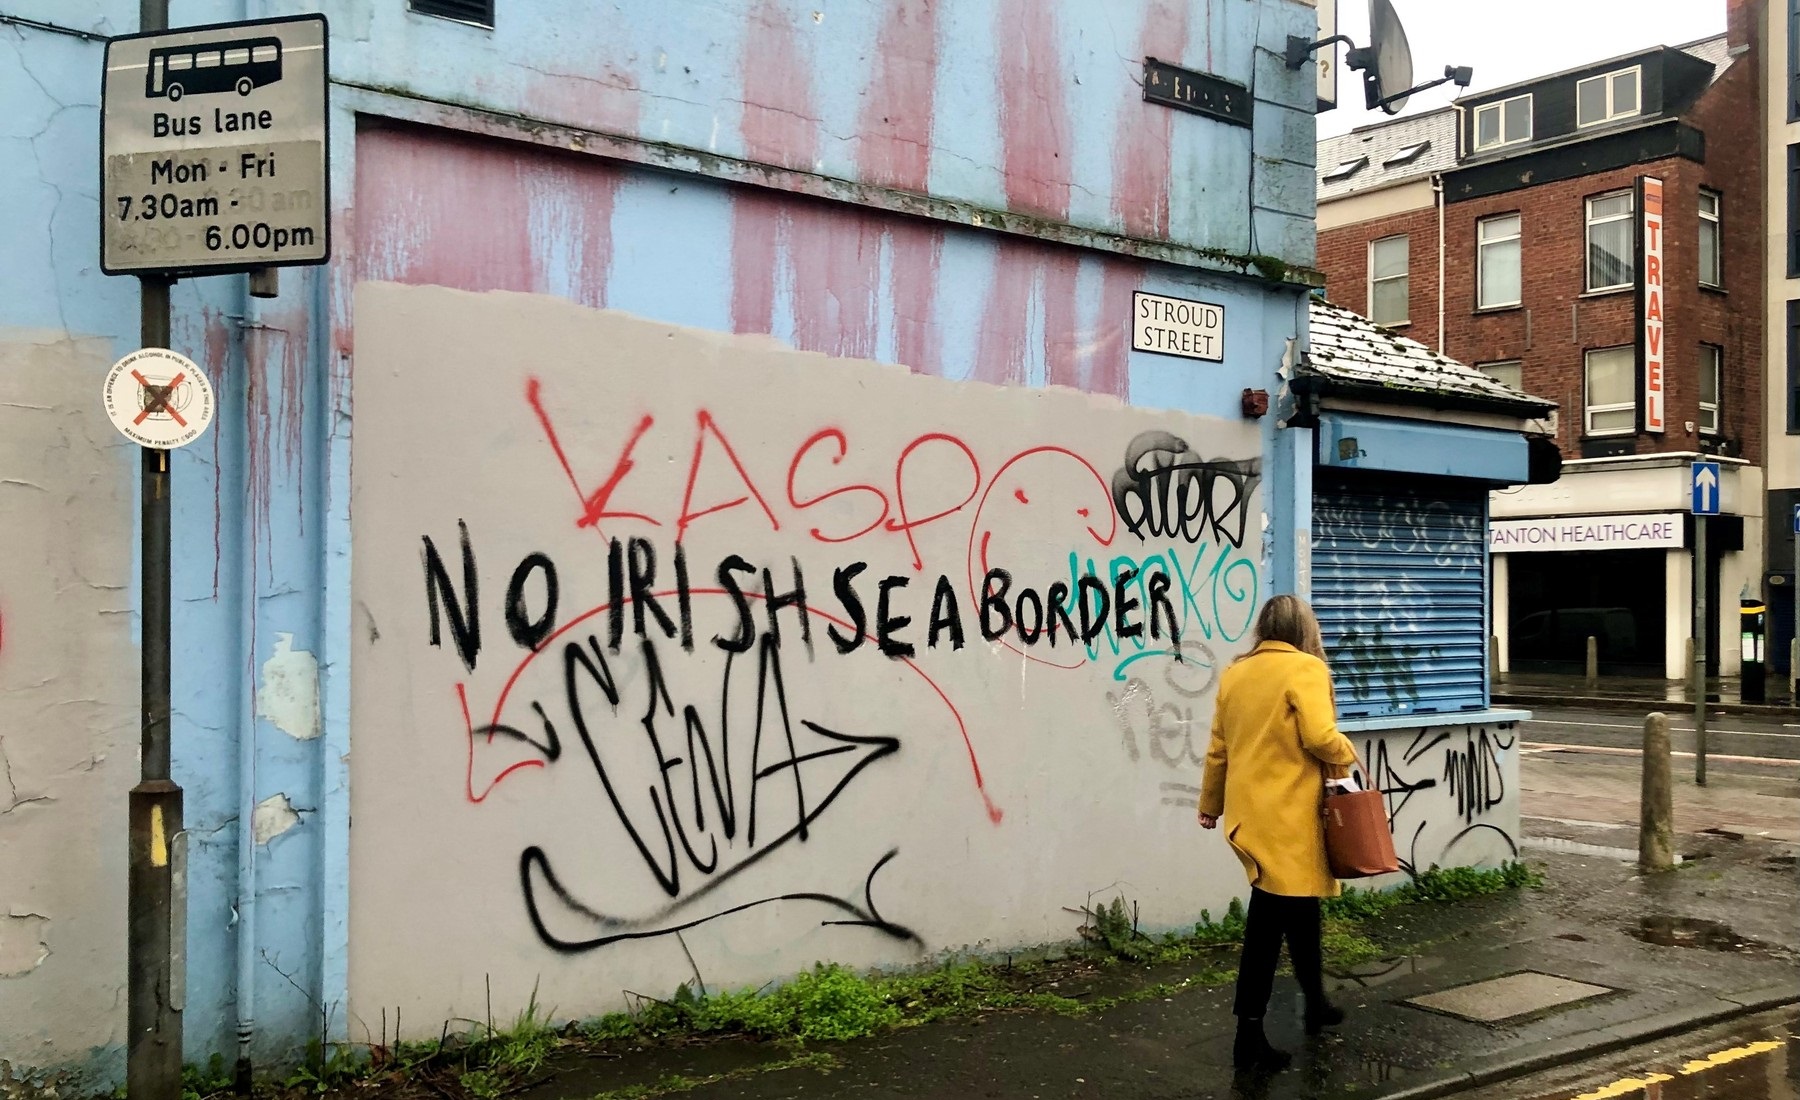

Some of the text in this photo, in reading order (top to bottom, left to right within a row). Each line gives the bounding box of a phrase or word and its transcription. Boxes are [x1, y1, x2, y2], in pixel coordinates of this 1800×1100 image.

[153, 107, 273, 138] Bus lane
[151, 159, 207, 185] Mon
[241, 152, 276, 179] Fri
[117, 193, 219, 221] 7.30am
[205, 222, 314, 252] 6.00pm
[1140, 298, 1218, 329] STROUD
[1647, 219, 1663, 427] TRAVEL
[1144, 326, 1214, 355] STREET
[124, 427, 152, 443] MAXIMUM
[1561, 522, 1673, 542] HEALTHCARE
[421, 518, 559, 674] NO
[608, 535, 816, 664] IRISH
[828, 561, 966, 661] SEA
[978, 566, 1185, 664] BORDER
